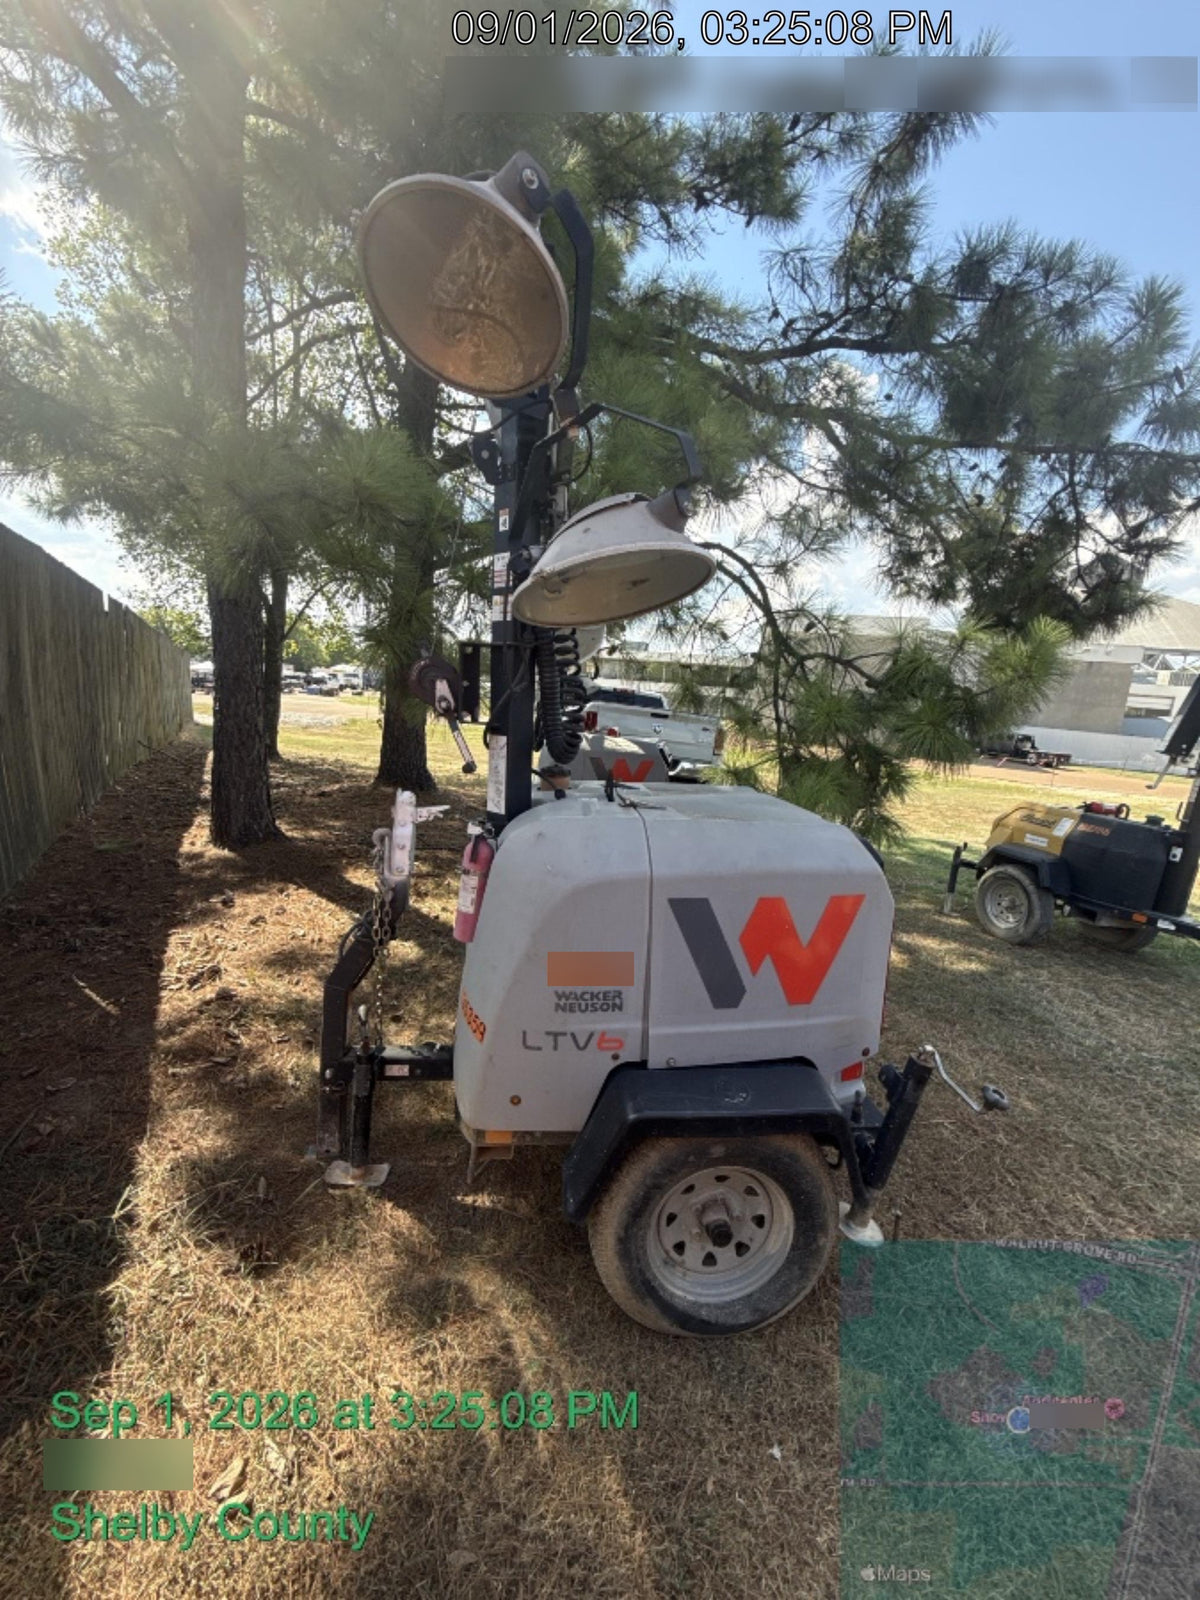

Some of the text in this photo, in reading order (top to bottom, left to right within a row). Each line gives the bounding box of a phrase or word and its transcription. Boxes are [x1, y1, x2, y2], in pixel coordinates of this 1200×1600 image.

[553, 989, 625, 1001] WACKER
[553, 1001, 625, 1015] NEUSON
[521, 1030, 625, 1052] LTV6
